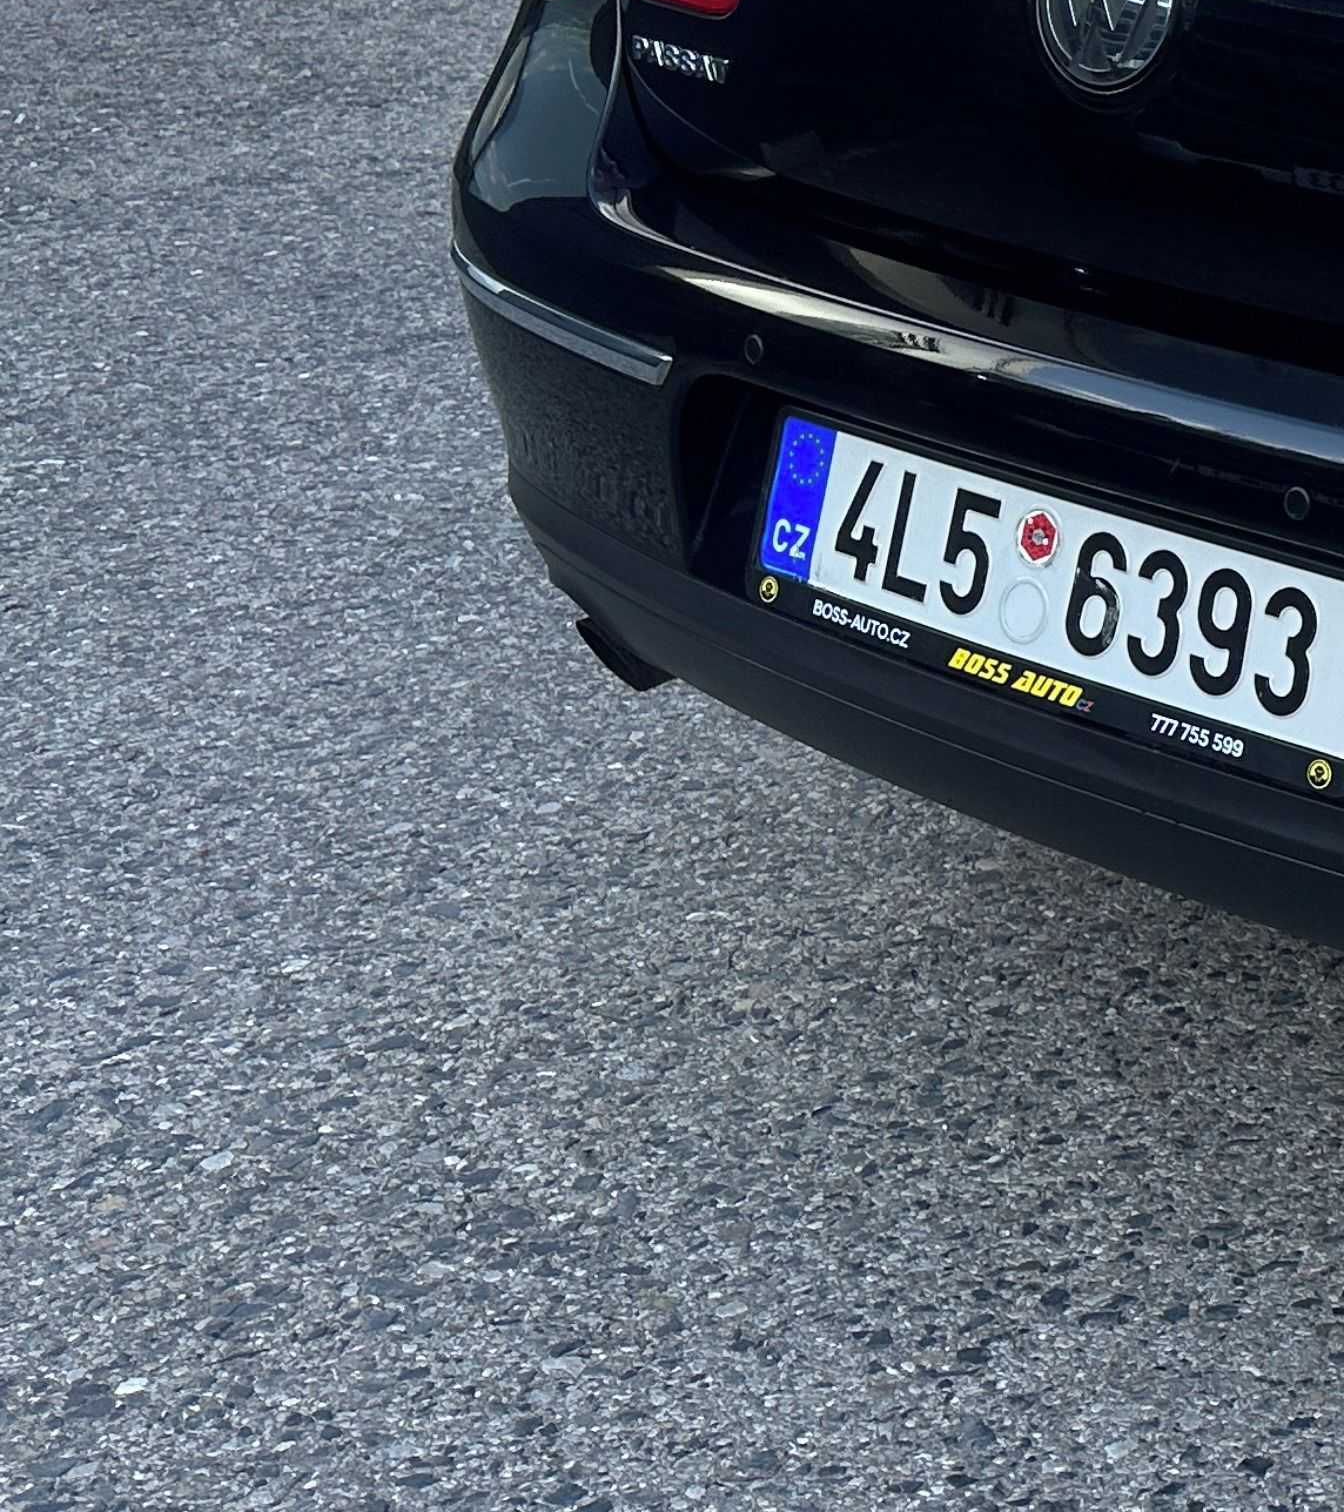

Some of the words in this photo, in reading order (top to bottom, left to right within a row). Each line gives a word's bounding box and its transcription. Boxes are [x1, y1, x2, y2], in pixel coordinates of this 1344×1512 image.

[632, 34, 730, 85] PASSAT
[772, 518, 811, 560] CZ
[835, 460, 1002, 615] 4L5
[1065, 531, 1318, 717] 6393
[812, 599, 912, 649] BOSS-AUTO.CZ
[948, 647, 1013, 685] BOSS
[1011, 670, 1083, 708] AUTO
[1151, 713, 1179, 737] 777
[1181, 723, 1210, 748] 755
[1211, 733, 1245, 758] 599
